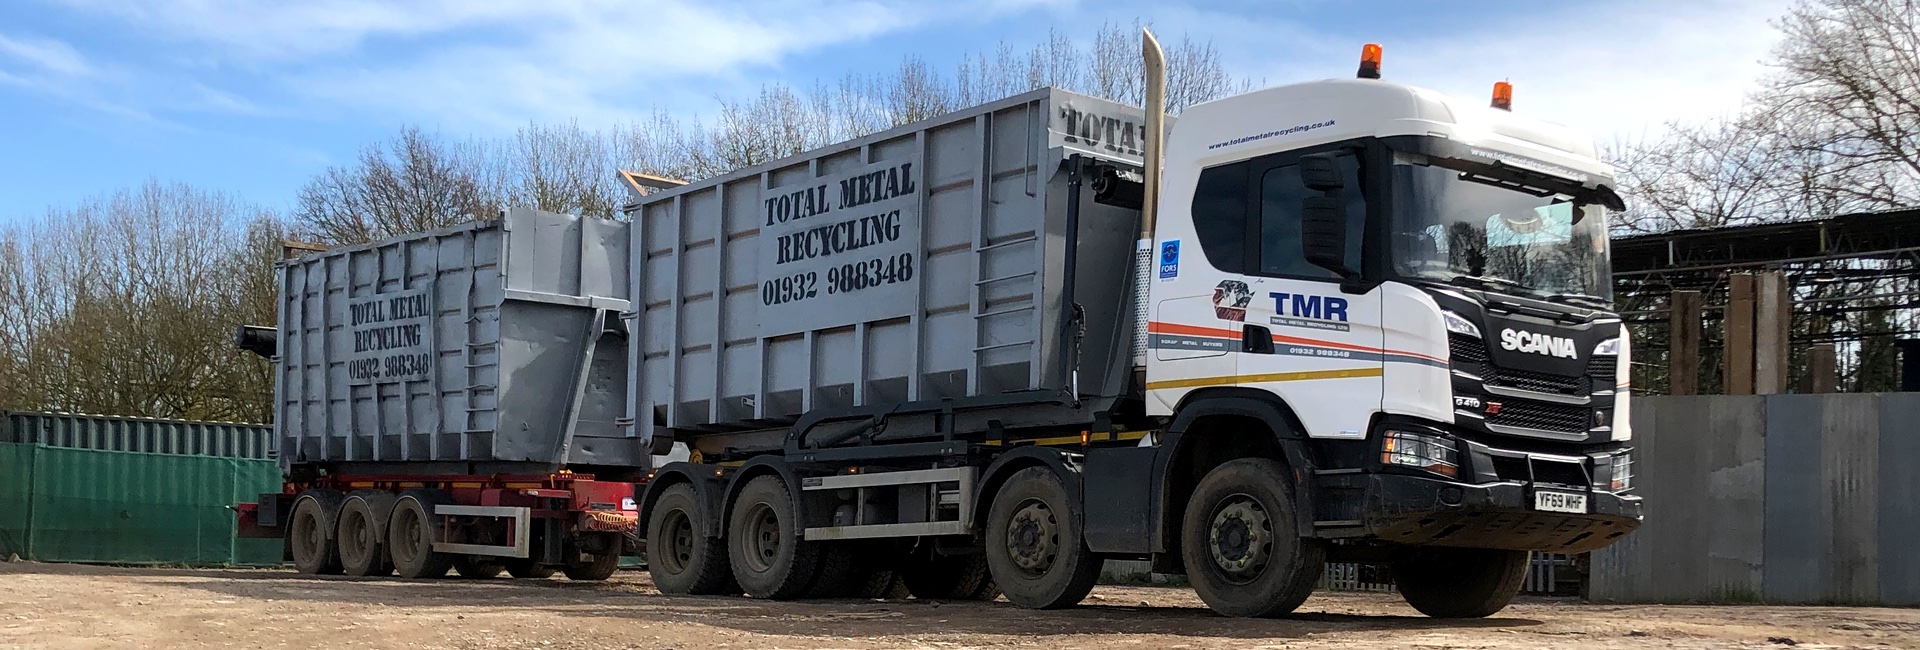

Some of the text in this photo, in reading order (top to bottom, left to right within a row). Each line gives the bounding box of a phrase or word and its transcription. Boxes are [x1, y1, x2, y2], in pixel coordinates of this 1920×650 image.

[1208, 119, 1335, 150] www.totalmetalrecycling.co.uk
[765, 163, 915, 226] TOTAL METAL
[776, 210, 901, 264] RECYCLING
[763, 253, 913, 306] 01932 988348
[1161, 264, 1177, 272] FORS
[350, 294, 428, 327] TOTAL METAL
[1269, 292, 1348, 322] TMR
[354, 324, 421, 353] RECYCLING
[1500, 328, 1578, 360] SCANIA
[349, 353, 429, 379] 01932 988348
[1539, 492, 1564, 508] YF69
